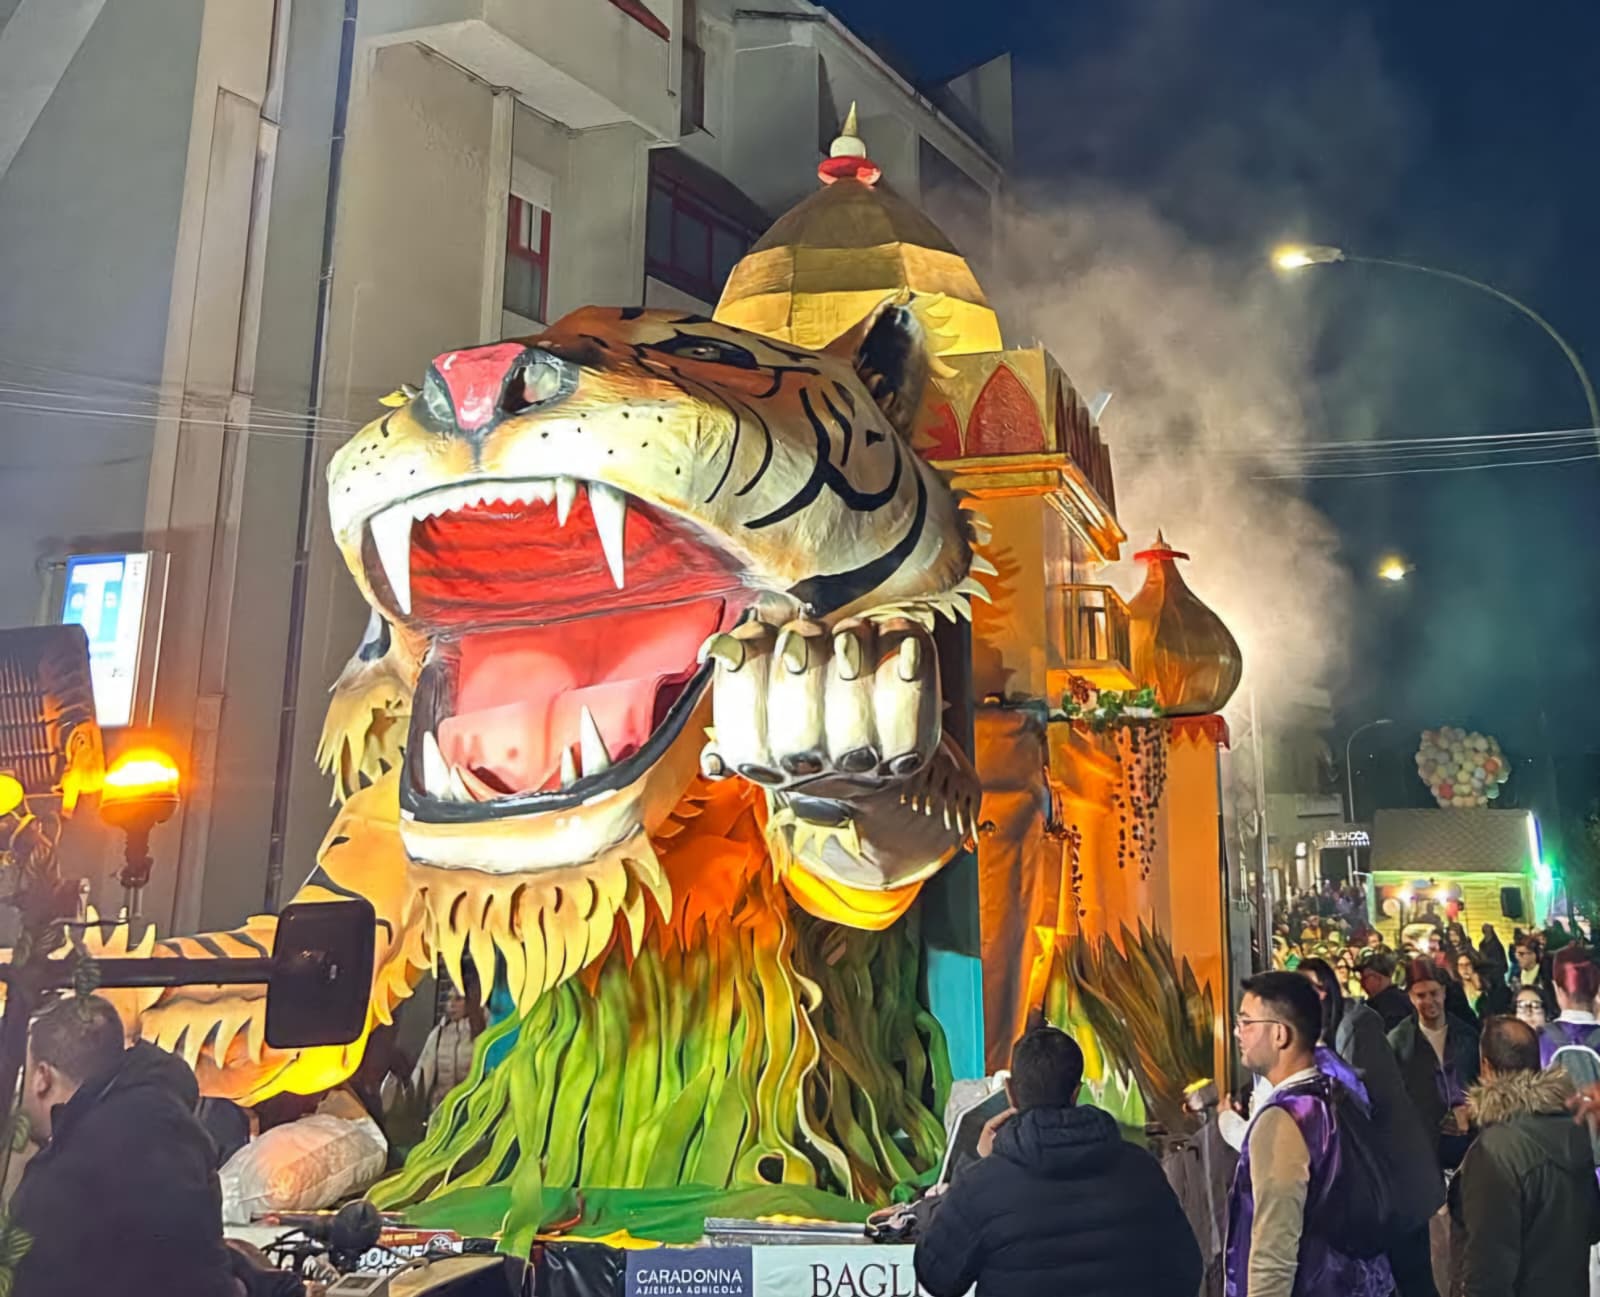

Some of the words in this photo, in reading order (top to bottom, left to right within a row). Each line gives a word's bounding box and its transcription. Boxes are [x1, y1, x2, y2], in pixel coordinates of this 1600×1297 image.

[636, 1268, 743, 1284] CARADONNA
[635, 1285, 682, 1295] AZIENDA
[686, 1285, 743, 1295] AGRICOLA
